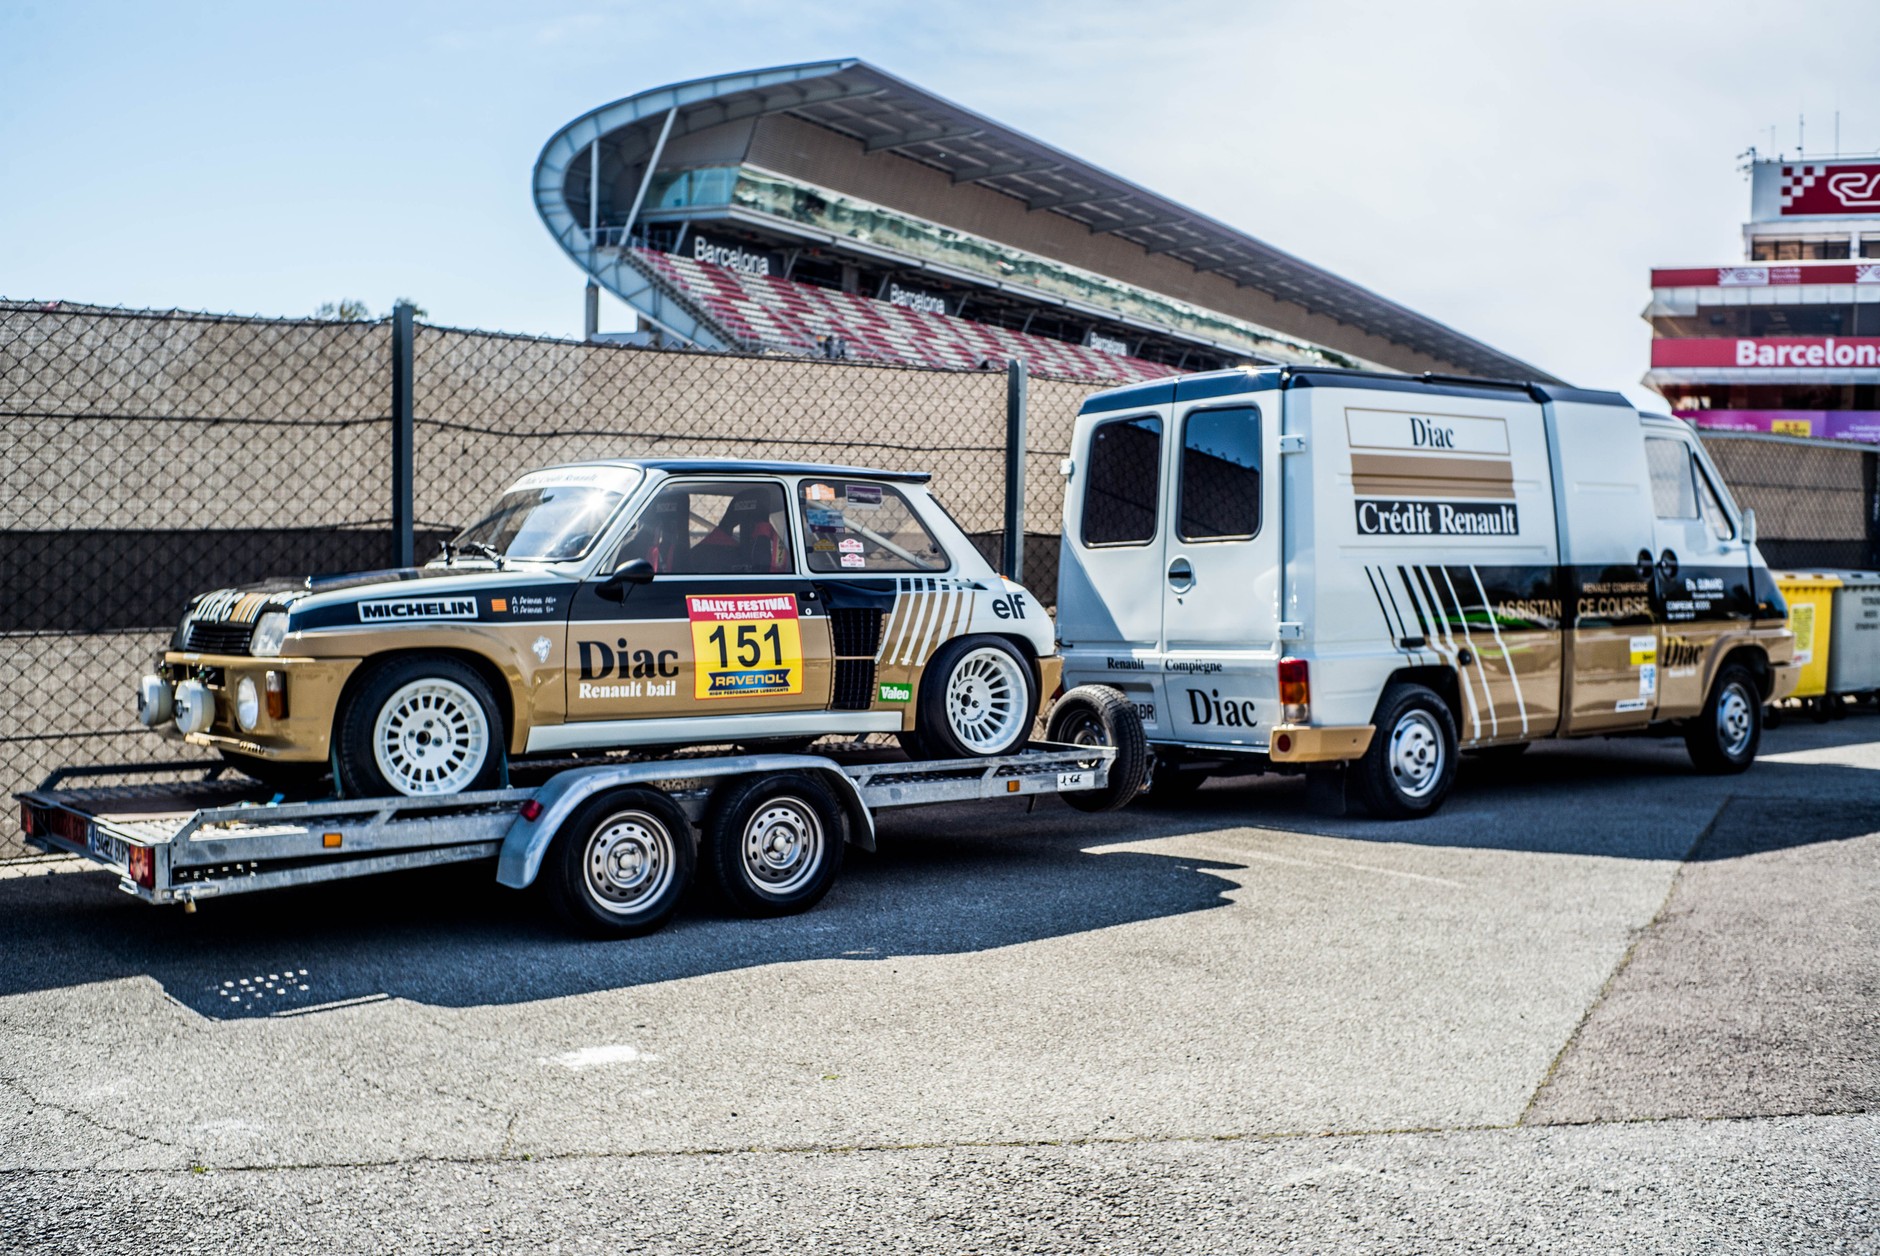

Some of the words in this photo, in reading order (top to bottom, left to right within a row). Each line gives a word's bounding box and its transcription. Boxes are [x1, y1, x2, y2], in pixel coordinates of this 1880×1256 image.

[694, 235, 770, 275] Barcelona
[890, 283, 945, 314] Barcelona
[1736, 338, 1880, 366] Barcelon
[1409, 417, 1455, 448] Diac
[1359, 501, 1433, 534] Crédit
[1437, 503, 1517, 534] Renault
[362, 601, 475, 619] MICHELIN
[691, 598, 736, 612] RALLYE
[737, 596, 792, 611] FESTIVAL
[714, 611, 775, 620] TRASMIERA
[992, 594, 1025, 619] elf
[1497, 599, 1562, 619] ASSISTAN
[1598, 596, 1650, 617] COURSE
[577, 638, 679, 680] Diac
[709, 624, 783, 668] 151
[1107, 657, 1145, 670] Renault
[1165, 659, 1222, 675] Compiègne
[579, 681, 641, 699] Renault
[646, 680, 676, 697] bail
[880, 686, 910, 700] Valeo
[1186, 688, 1258, 728] Diac
